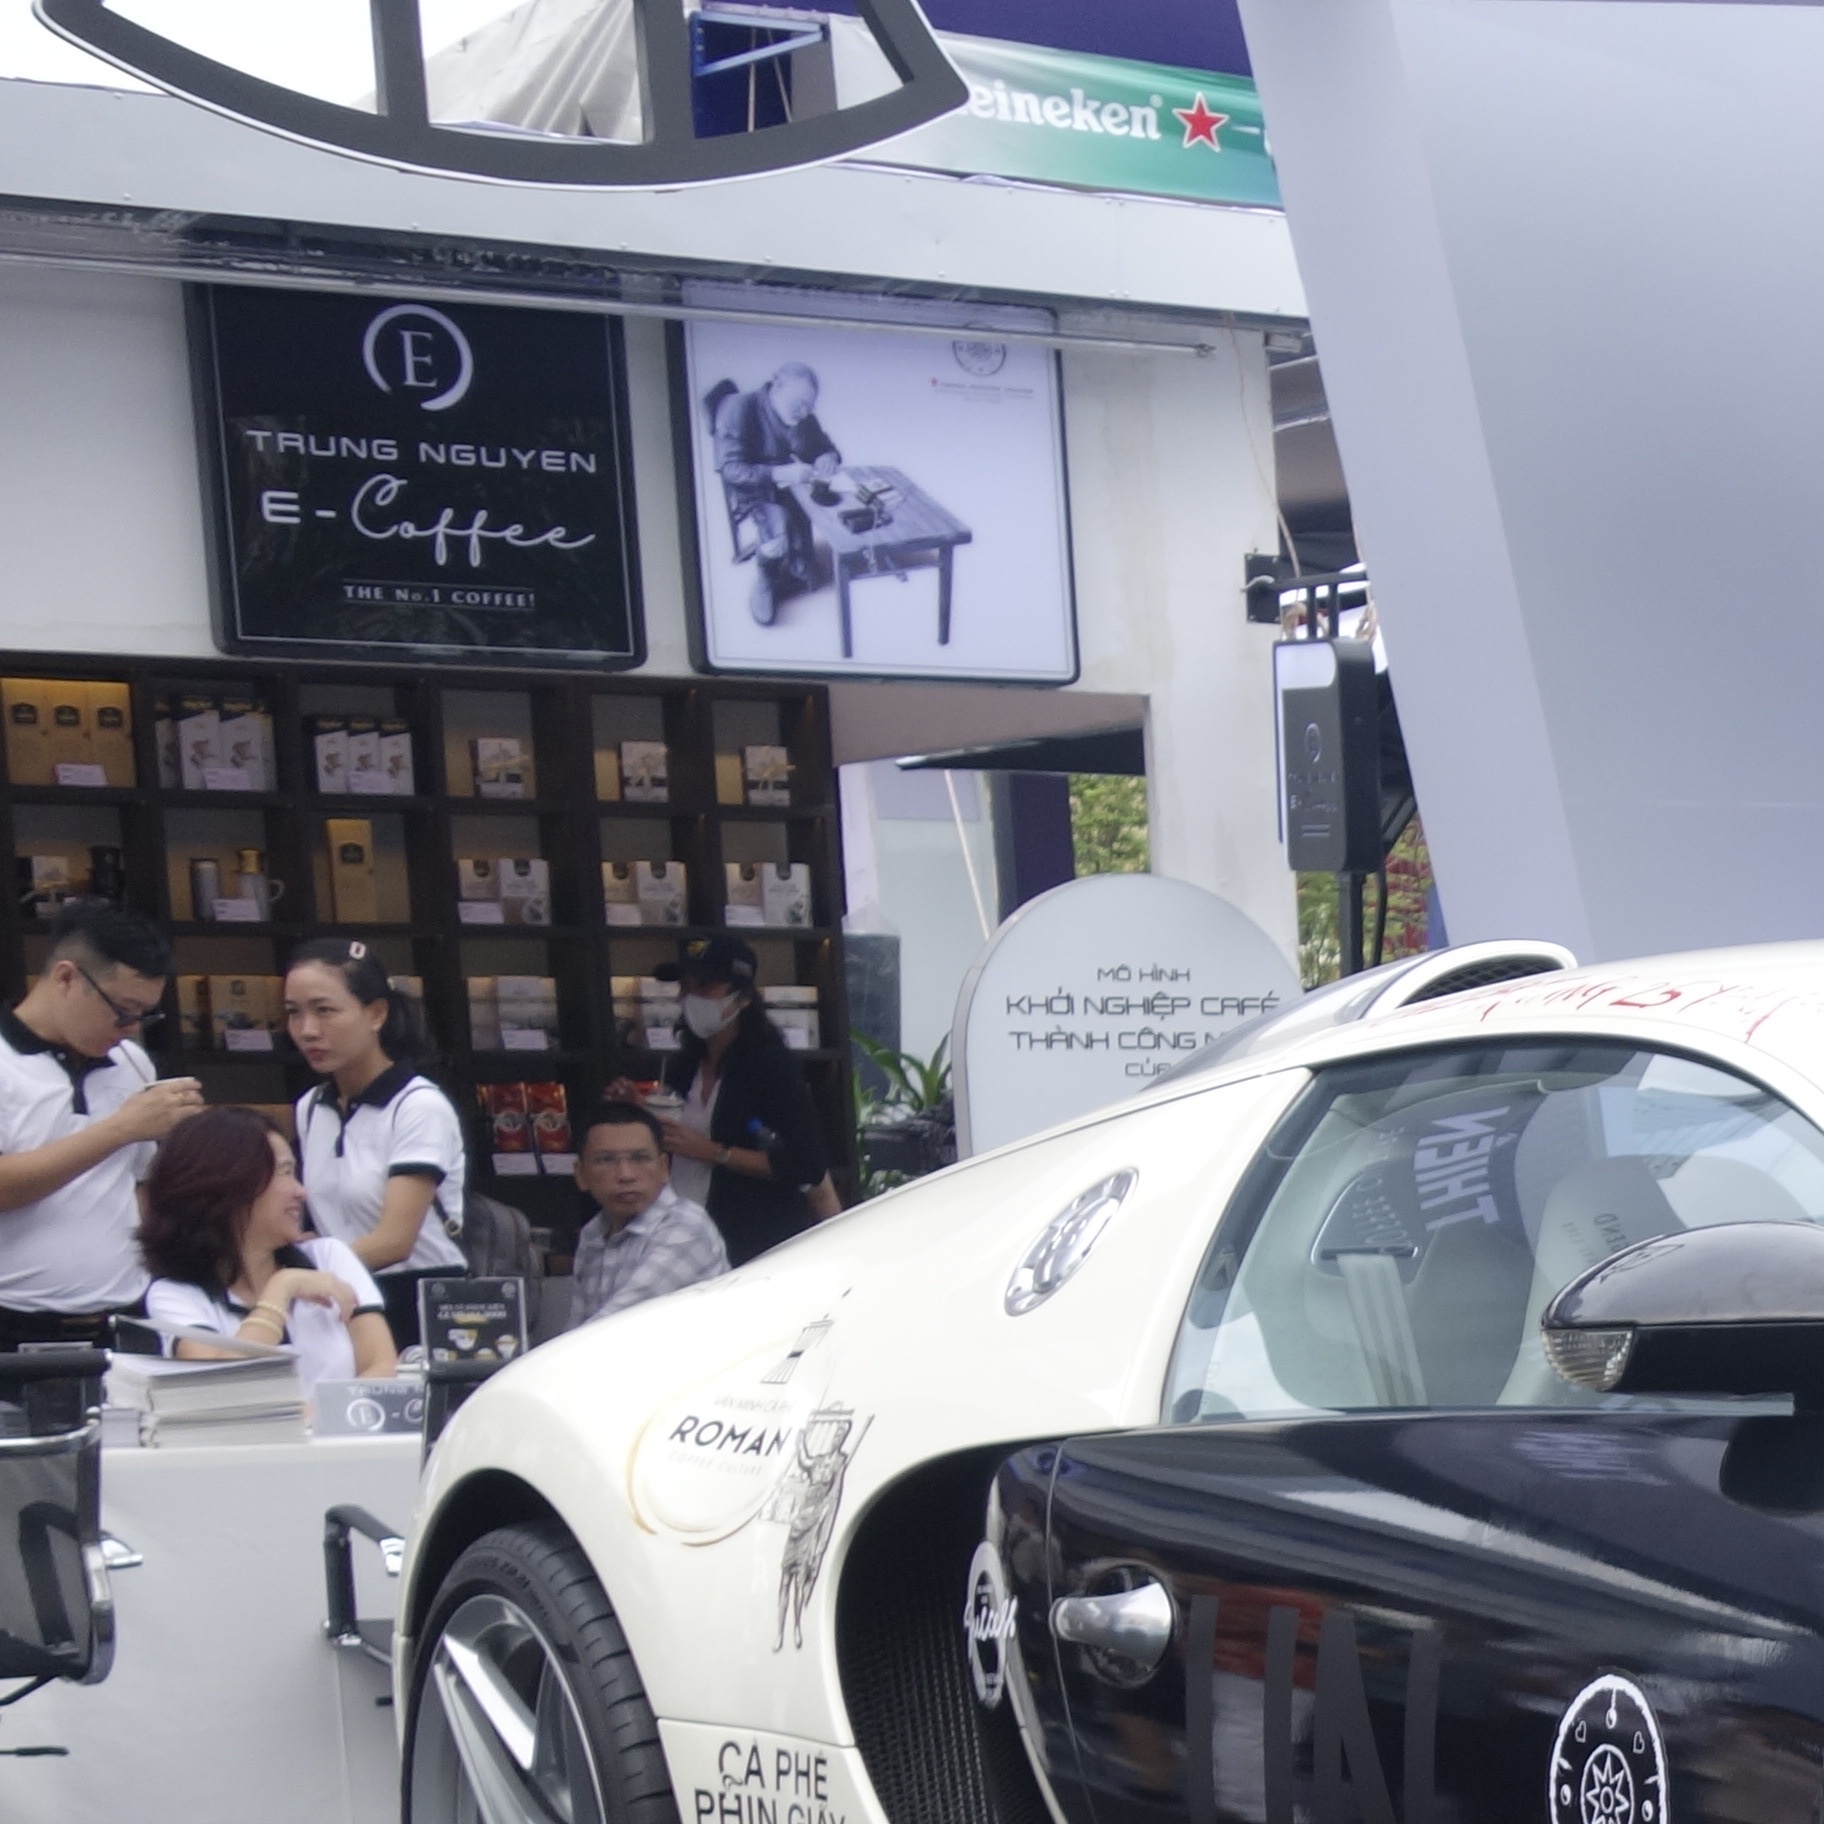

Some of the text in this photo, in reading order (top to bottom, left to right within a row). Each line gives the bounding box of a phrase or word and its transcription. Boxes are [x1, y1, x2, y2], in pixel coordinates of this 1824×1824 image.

[955, 78, 1162, 140] eineken
[246, 430, 597, 473] TRUNG NGUYEN
[343, 585, 384, 600] THE
[1097, 963, 1132, 981] MÔ
[1009, 1025, 1109, 1051] THÀNH
[1118, 1027, 1197, 1051] CÔNG
[668, 1415, 793, 1457] ROMAN
